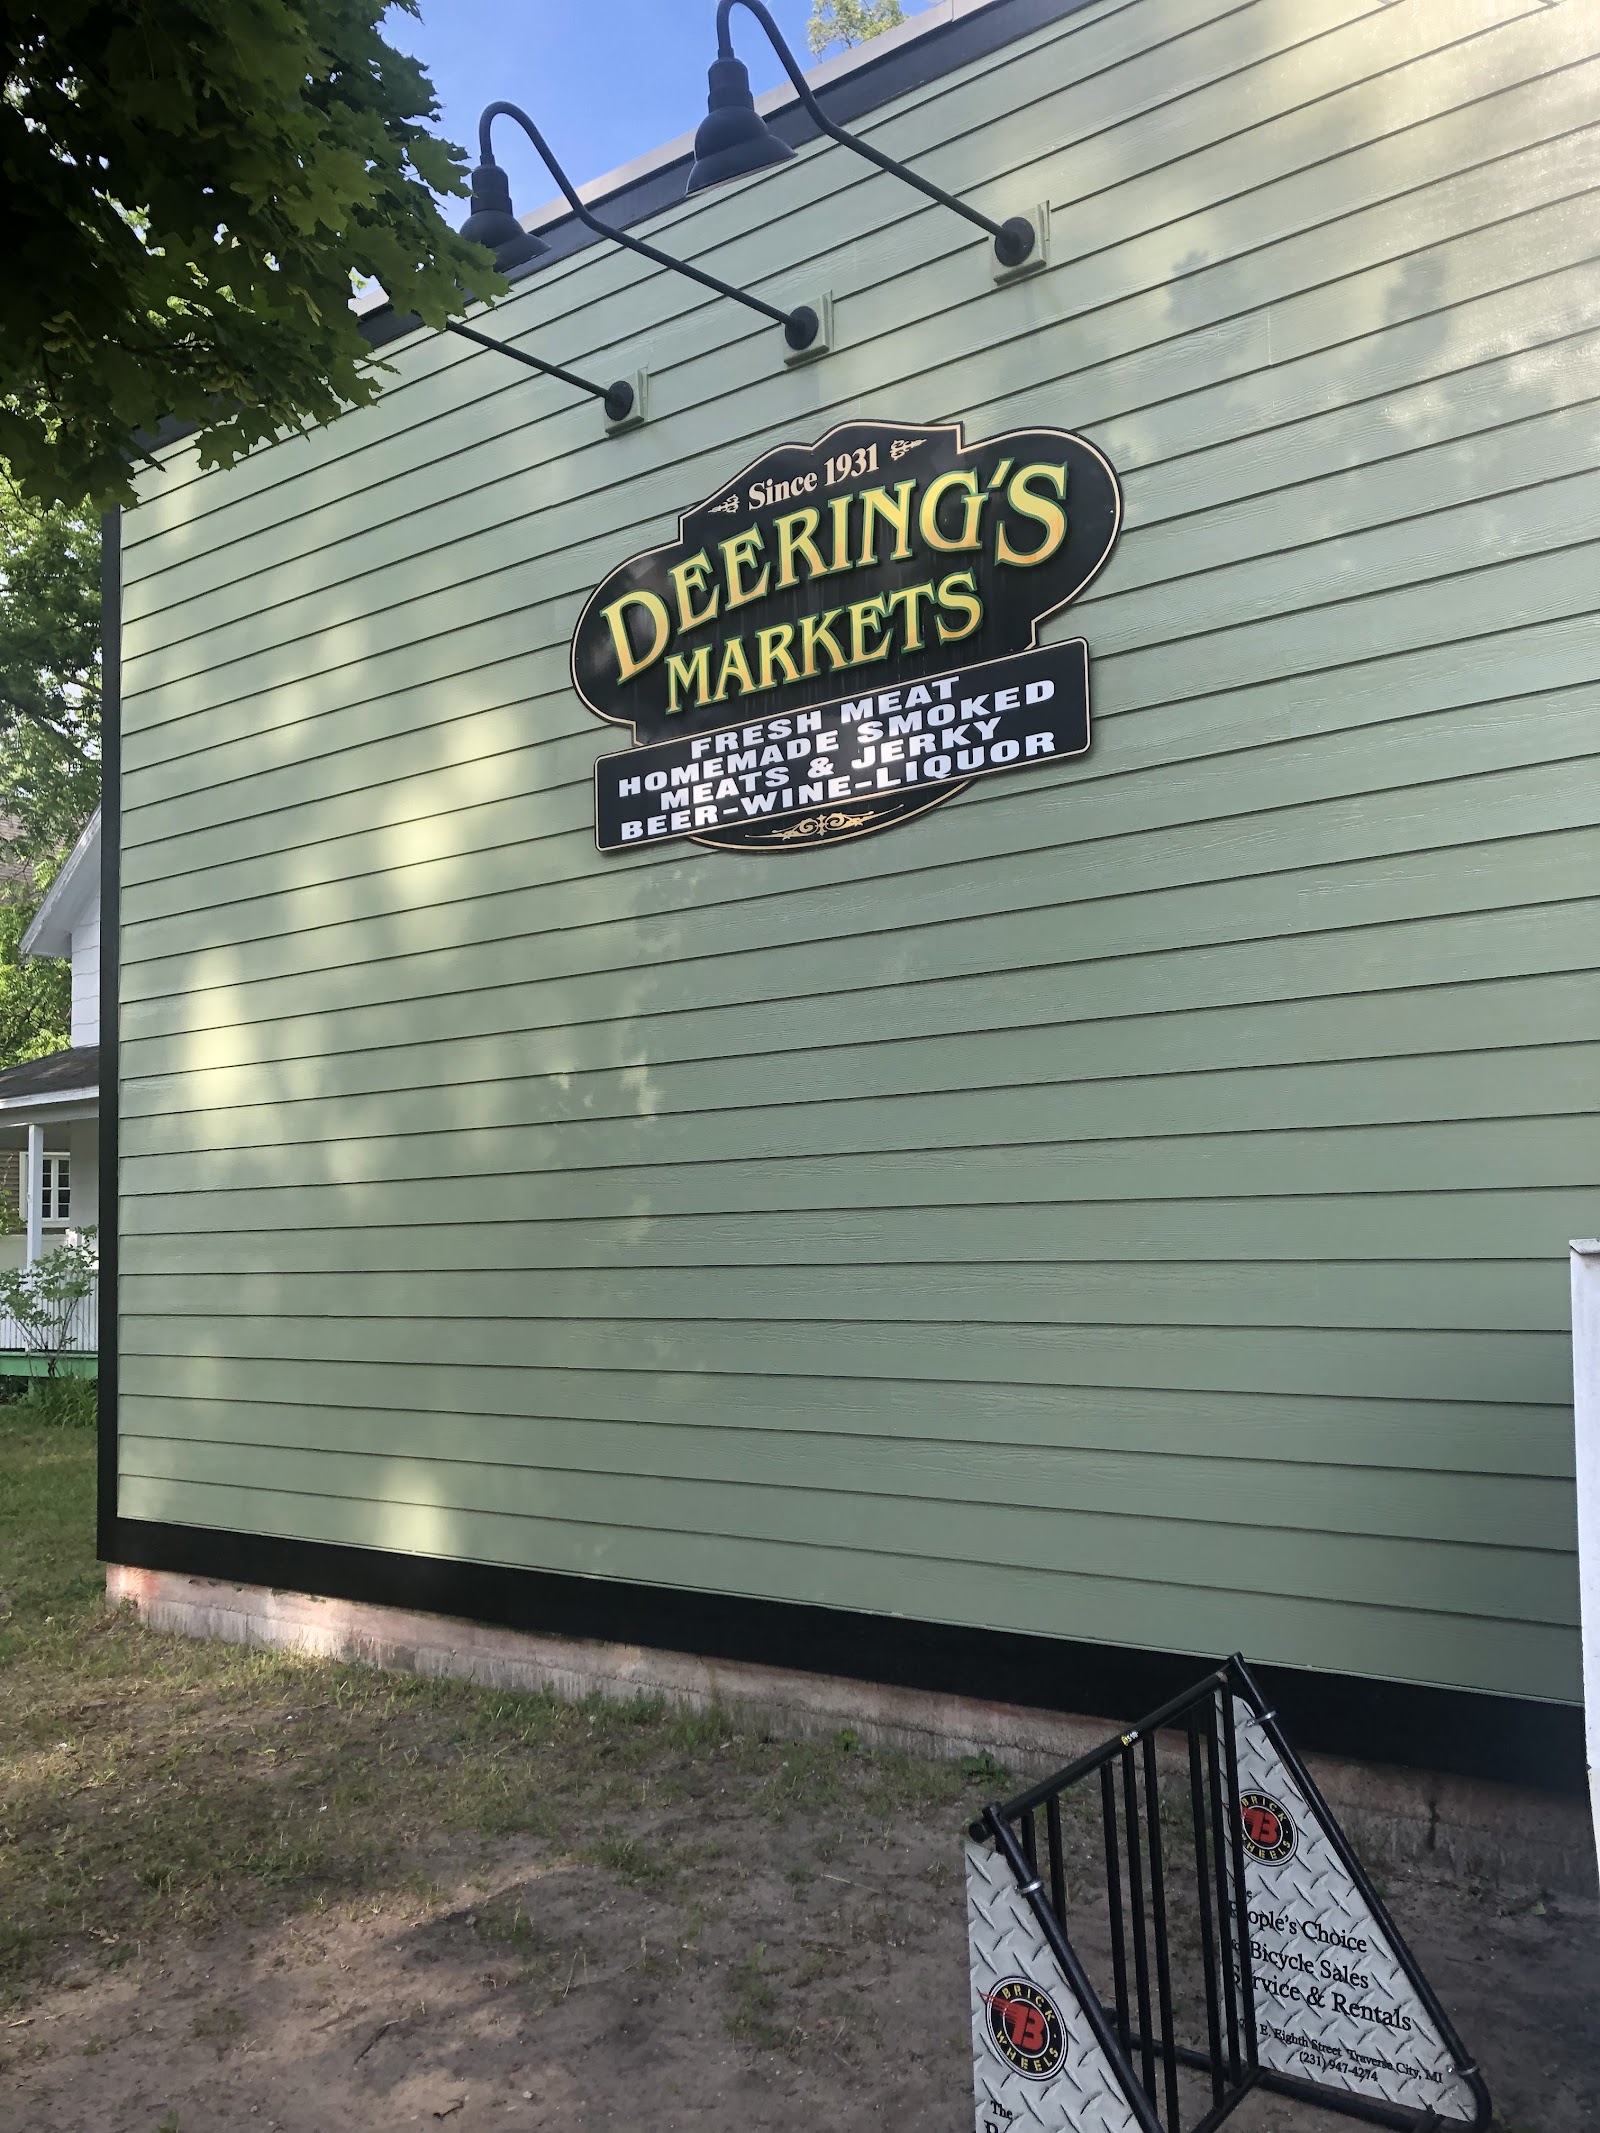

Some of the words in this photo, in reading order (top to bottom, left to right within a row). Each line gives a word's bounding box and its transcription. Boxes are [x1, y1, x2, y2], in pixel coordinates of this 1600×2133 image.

[748, 478, 818, 511] Since
[823, 443, 880, 487] 1931
[600, 457, 1069, 685] DEERING'S
[665, 570, 983, 715] MARKETS
[618, 729, 839, 798] HOMEMADE
[857, 679, 1055, 744] SMOKED
[691, 709, 823, 760] FRESH
[840, 676, 960, 724] MEAT
[660, 766, 790, 811] MEATS
[807, 756, 835, 779] &
[851, 716, 1002, 770] JERKY
[1241, 1795, 1286, 1821] BRICK
[1302, 1920, 1367, 1953] Choice
[1250, 1940, 1314, 1975] Bicycle
[1320, 1959, 1369, 1989] Sales
[1002, 1984, 1056, 2022] BRICK
[1306, 1986, 1326, 2009] &
[1331, 1991, 1412, 2031] Rentals
[996, 2030, 1058, 2072] WHEELS
[1260, 2024, 1271, 2037] E.
[1274, 2027, 1309, 2048] Eighth
[1311, 2039, 1342, 2057] Street
[1299, 2051, 1326, 2070] (231)
[1328, 2058, 1378, 2082] 947-4274
[990, 2100, 1013, 2120] The
